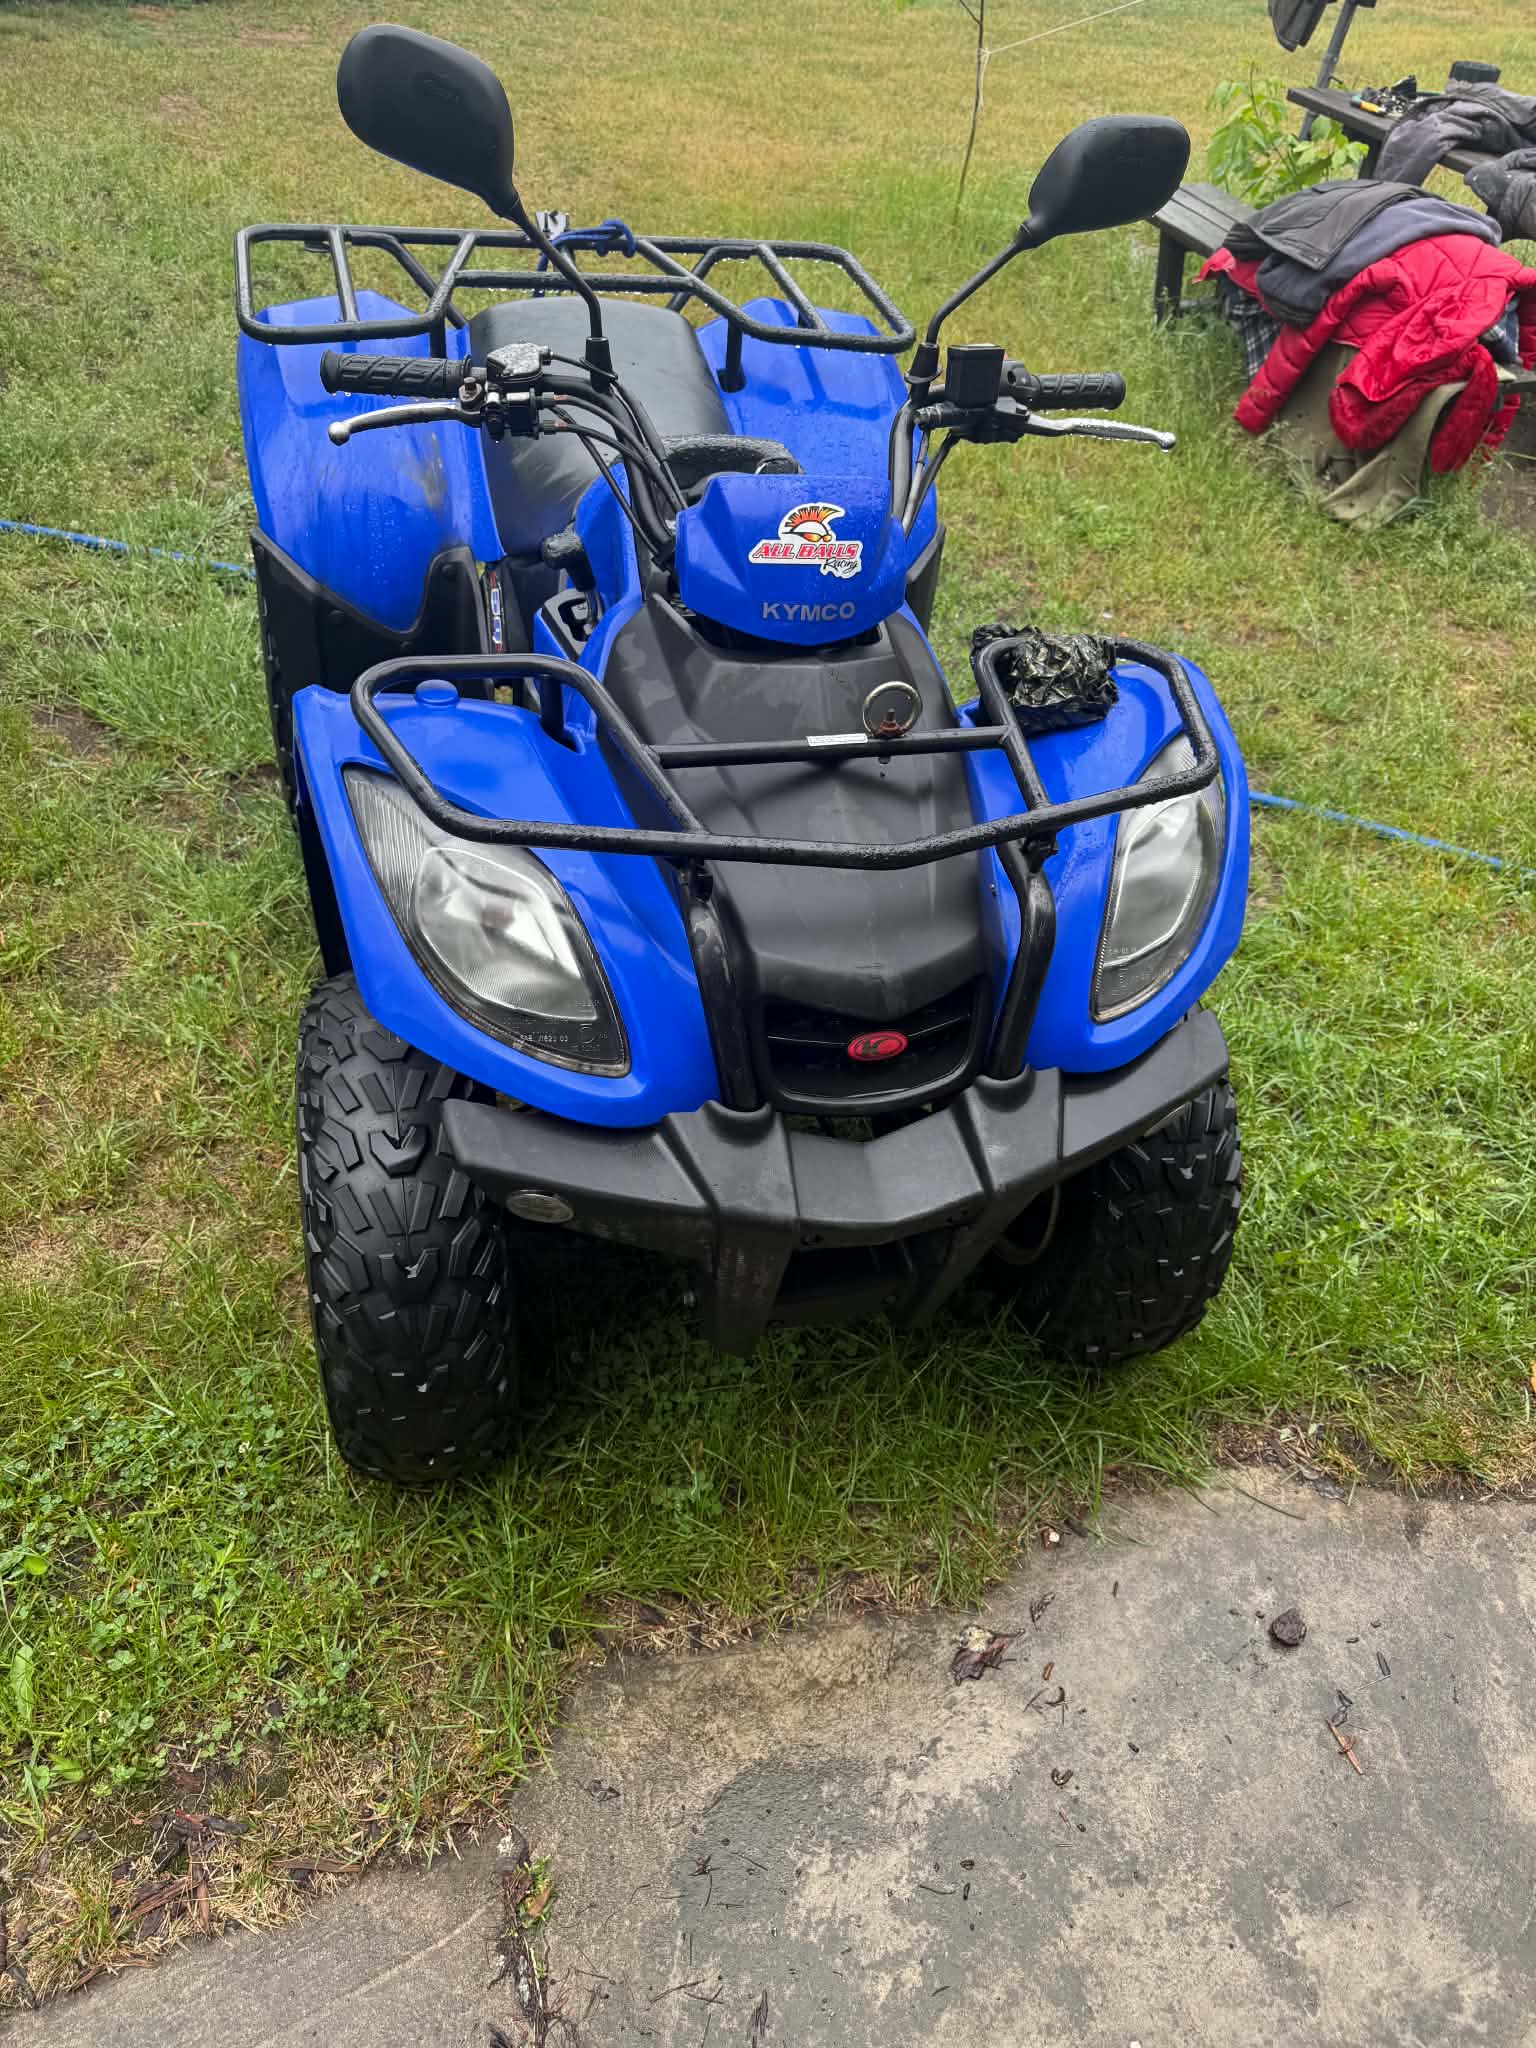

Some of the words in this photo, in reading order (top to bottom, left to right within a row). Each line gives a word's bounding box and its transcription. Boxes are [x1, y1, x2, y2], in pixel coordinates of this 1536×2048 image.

[752, 542, 796, 560] ALL
[796, 542, 860, 560] BALLS
[822, 558, 859, 575] Racing
[762, 601, 856, 621] KYMCO
